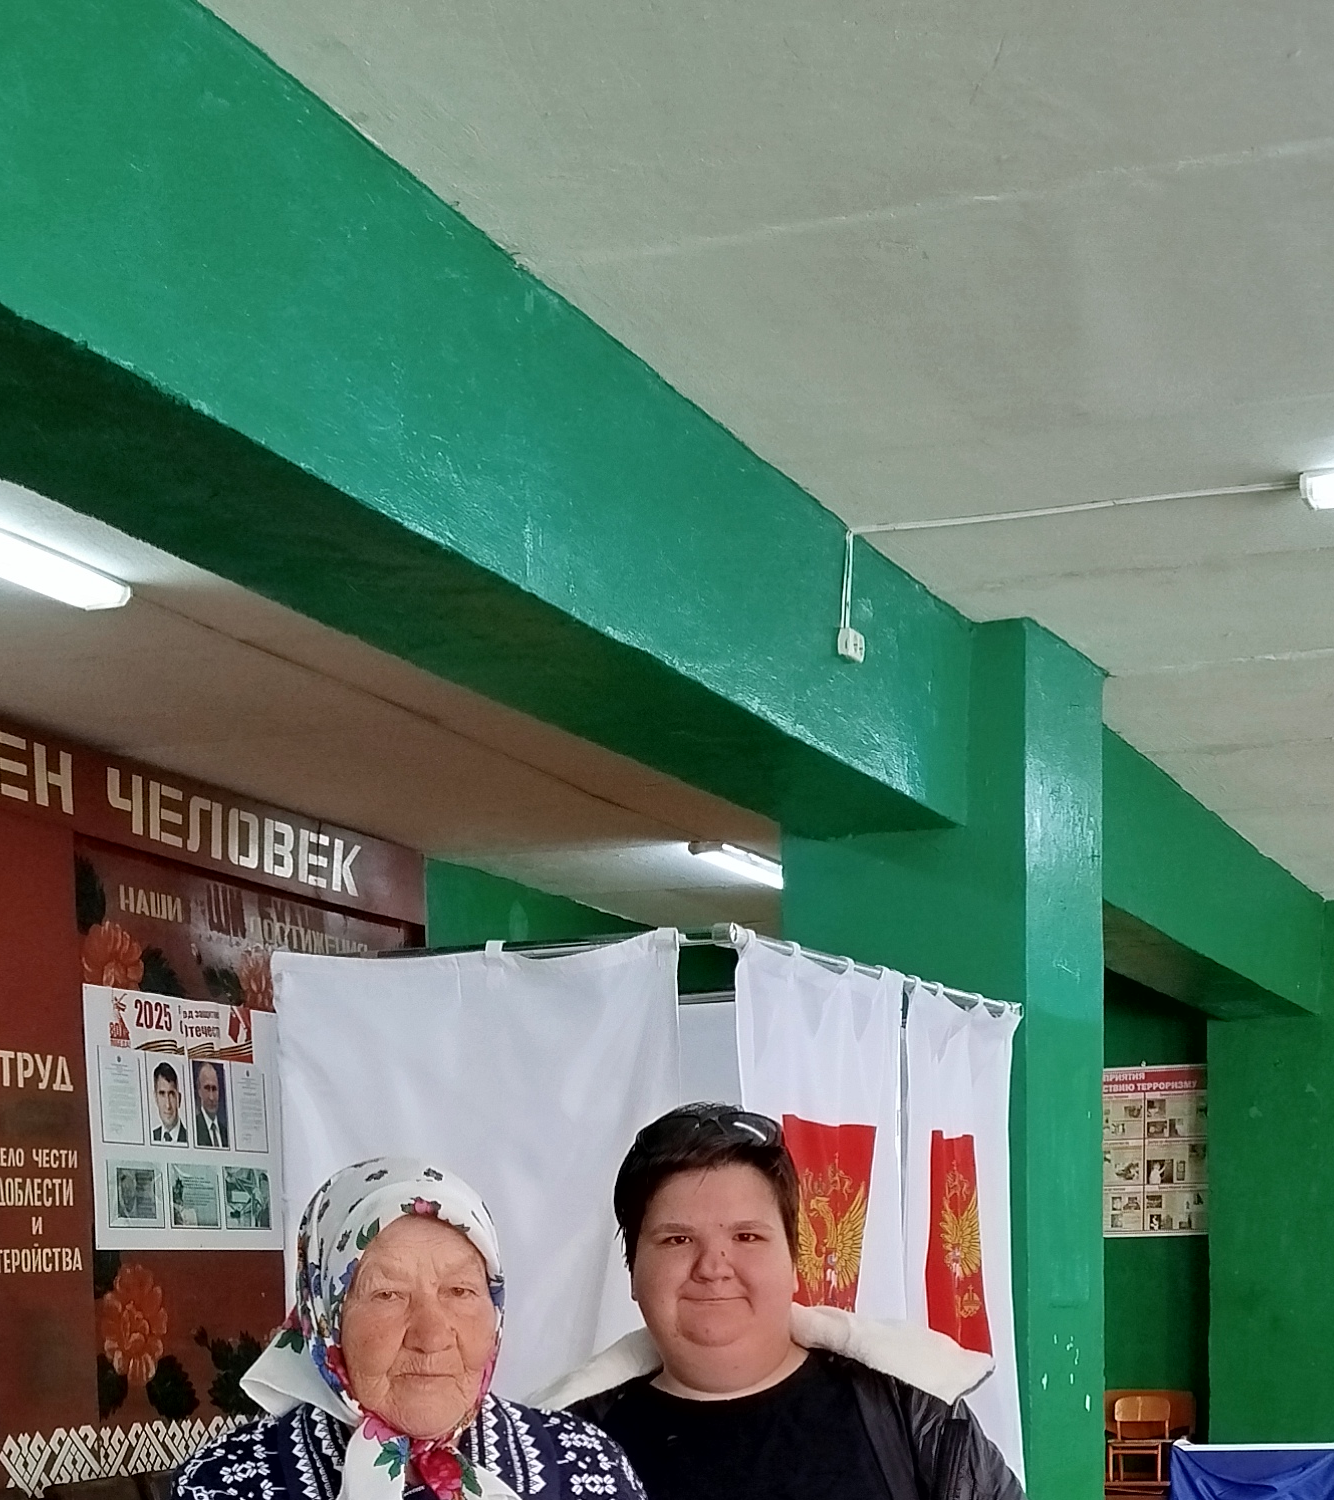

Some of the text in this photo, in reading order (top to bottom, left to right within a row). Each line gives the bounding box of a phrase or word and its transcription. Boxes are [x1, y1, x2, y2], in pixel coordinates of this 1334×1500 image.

[107, 766, 361, 897] ЧЕЛОВЕК
[119, 884, 183, 923] НАШИ
[134, 999, 172, 1032] 2025
[1136, 1080, 1198, 1091] ТЕРРОРИЗМУ
[32, 1148, 78, 1169] ЧЕСТИ
[31, 1216, 43, 1235] И
